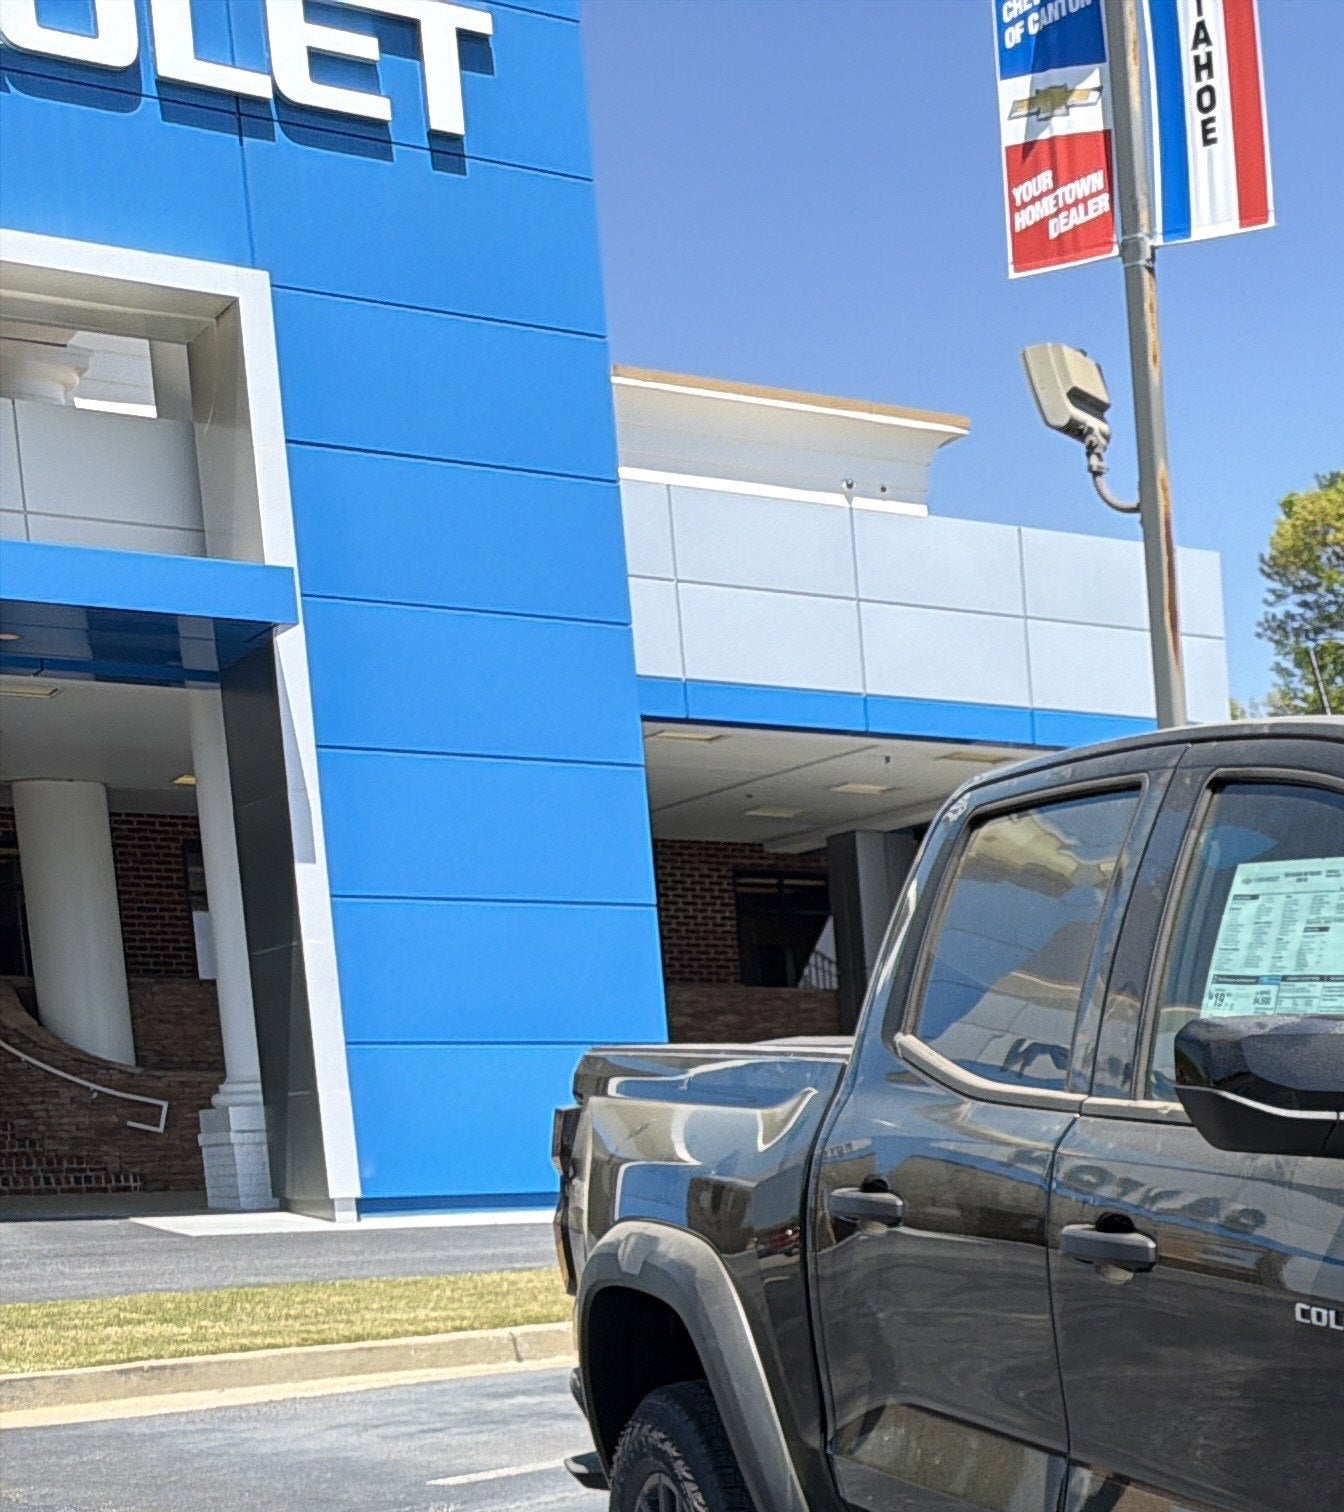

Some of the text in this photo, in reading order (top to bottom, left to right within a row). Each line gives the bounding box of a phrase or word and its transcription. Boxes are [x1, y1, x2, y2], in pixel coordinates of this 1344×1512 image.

[1004, 21, 1025, 49] OF
[1011, 169, 1054, 206] YOUR
[1014, 169, 1105, 233] HOMETOWN
[1048, 192, 1111, 240] DEALER
